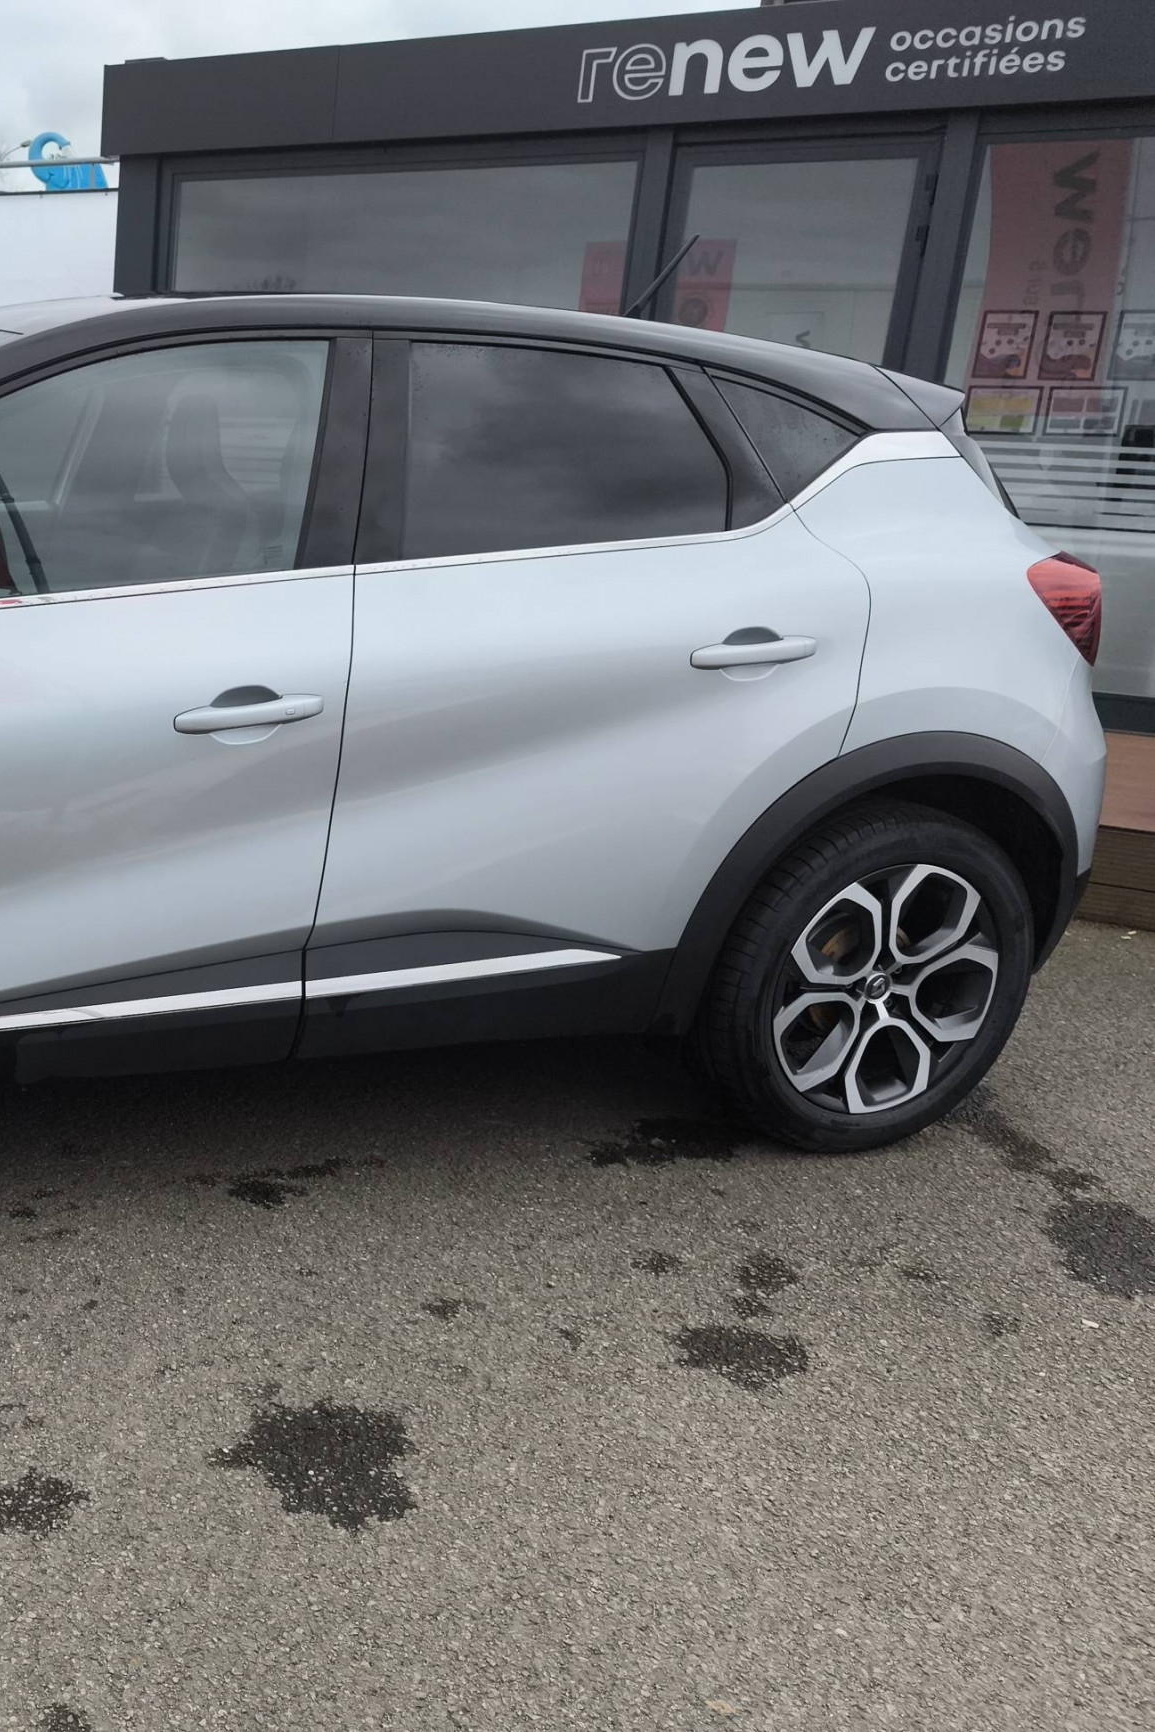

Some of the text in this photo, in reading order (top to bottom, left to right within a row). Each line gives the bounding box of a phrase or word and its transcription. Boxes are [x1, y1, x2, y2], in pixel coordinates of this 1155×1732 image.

[889, 15, 1087, 52] occasions
[577, 26, 877, 103] renew
[885, 46, 1066, 82] certifiées
